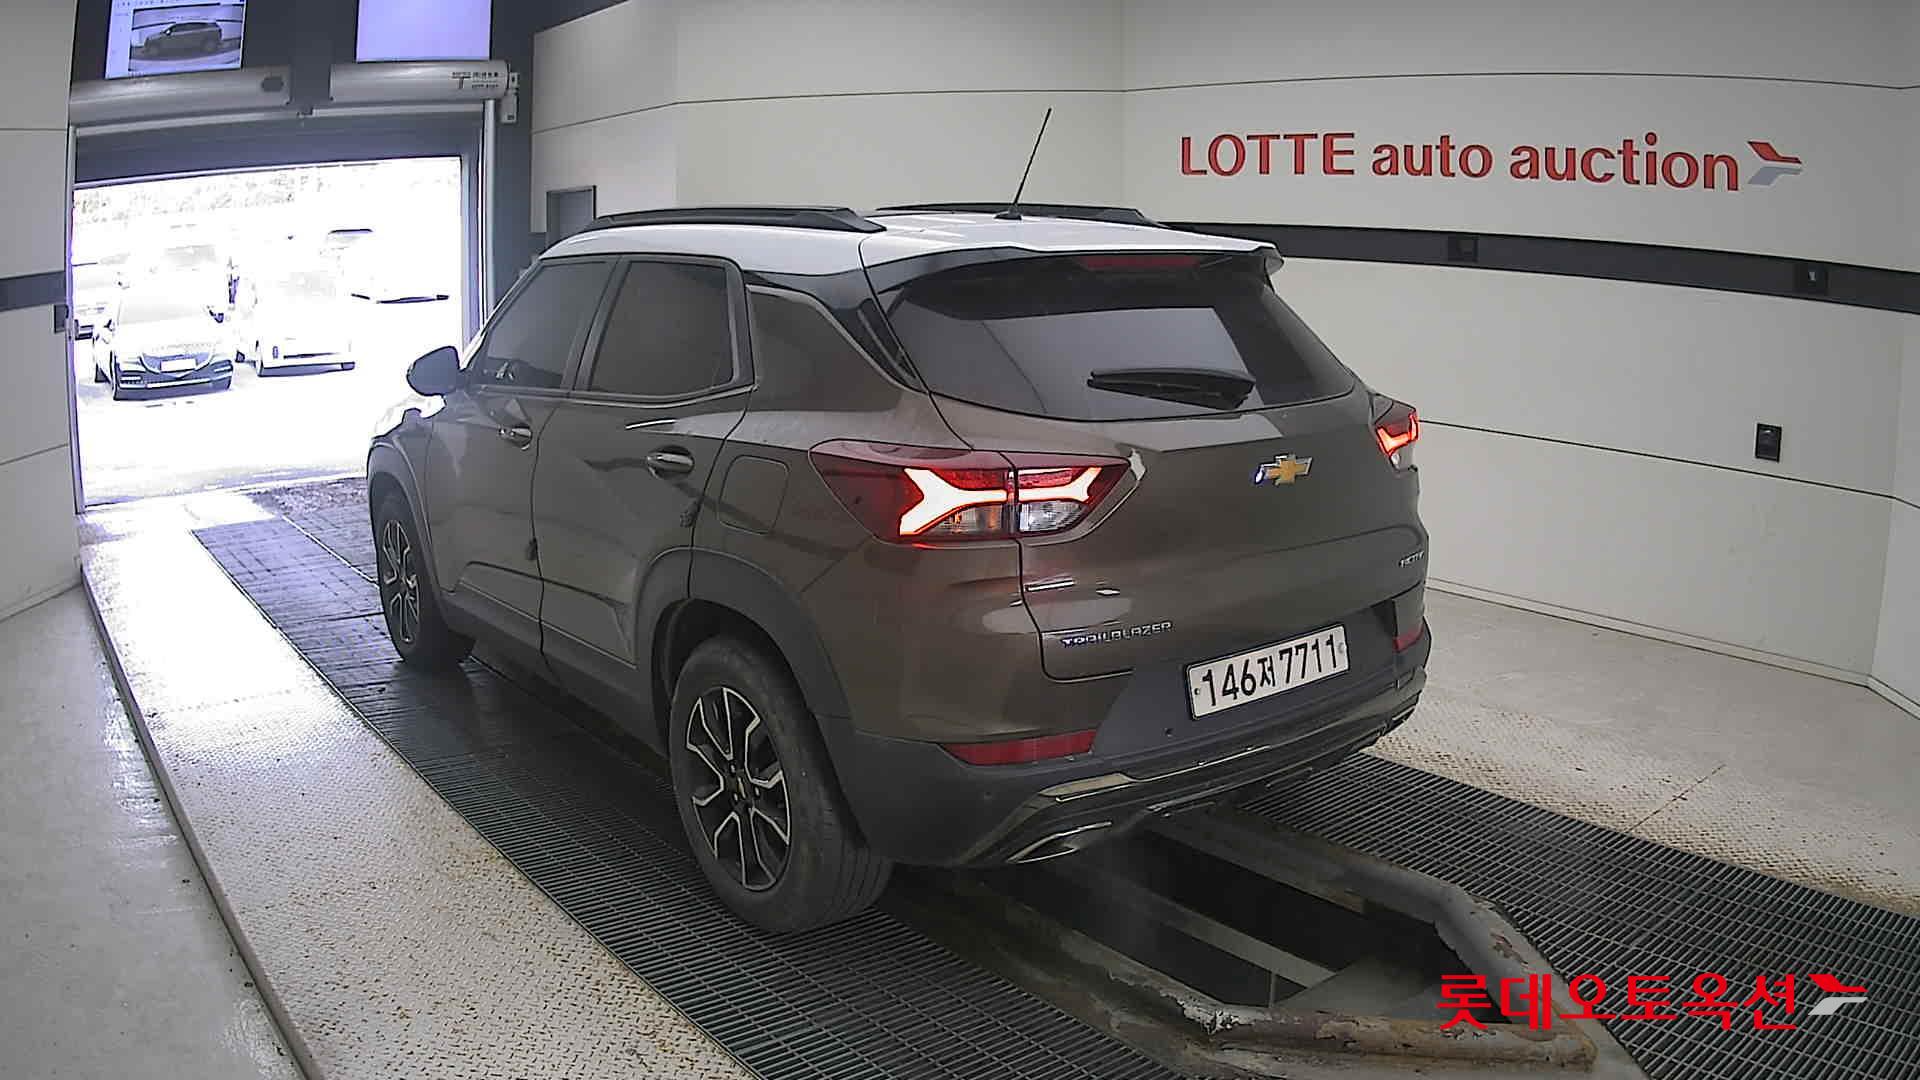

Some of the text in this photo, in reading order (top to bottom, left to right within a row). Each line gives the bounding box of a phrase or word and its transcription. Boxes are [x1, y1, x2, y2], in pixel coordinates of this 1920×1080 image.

[1181, 132, 1739, 191] LOTTE auto auction
[1061, 621, 1172, 647] TRAILBLAZER
[1202, 634, 1338, 706] 146저7711
